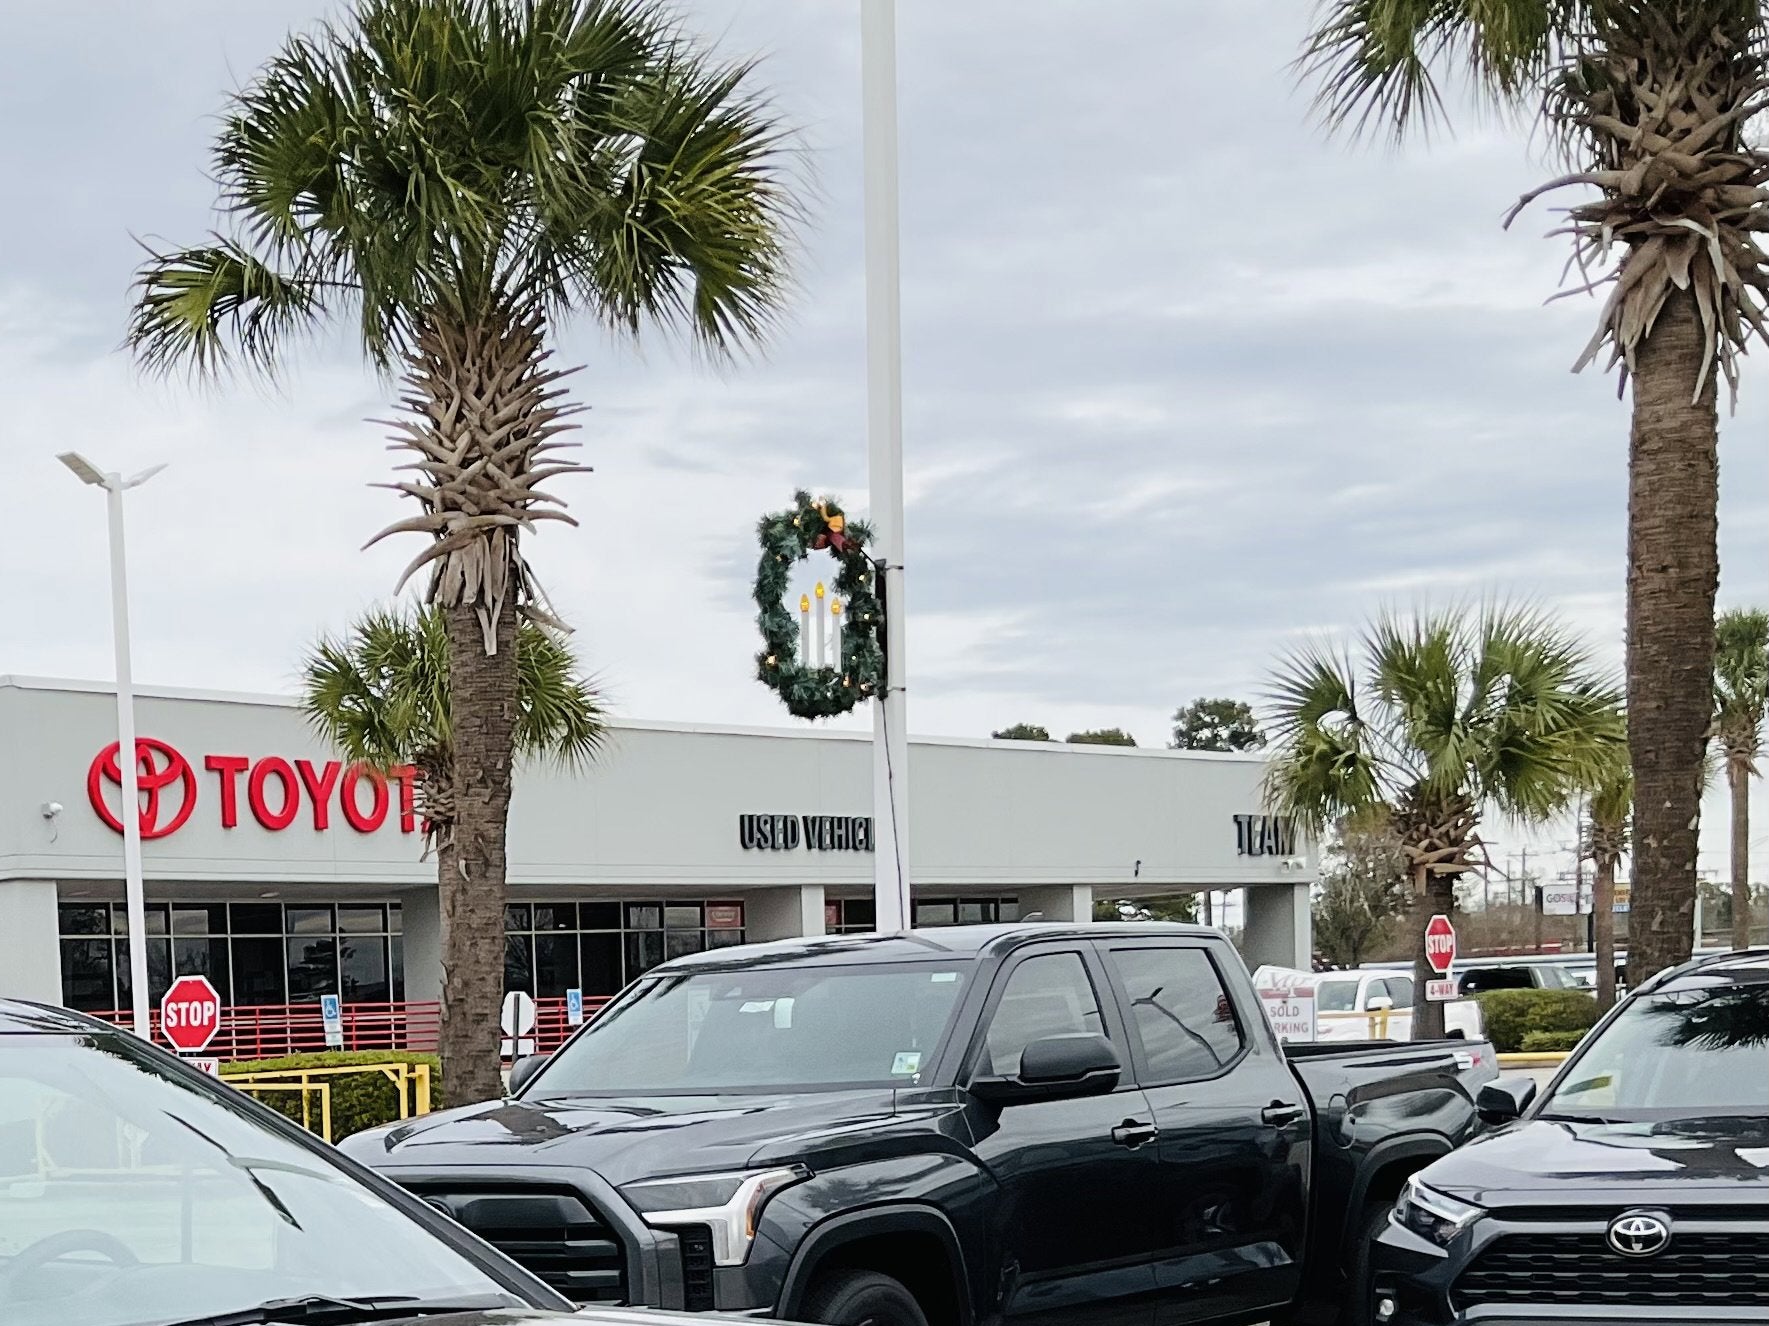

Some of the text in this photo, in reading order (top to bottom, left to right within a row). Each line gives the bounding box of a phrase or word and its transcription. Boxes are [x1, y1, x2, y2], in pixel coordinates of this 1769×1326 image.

[205, 755, 429, 834] TOYOT
[740, 814, 799, 849] USED
[1233, 815, 1295, 855] TEAM
[1428, 934, 1453, 954] STOP
[1430, 983, 1454, 996] 4-WAY
[166, 1000, 215, 1028] STOP
[1270, 1006, 1299, 1018] SOLD
[1274, 1022, 1309, 1034] RKING
